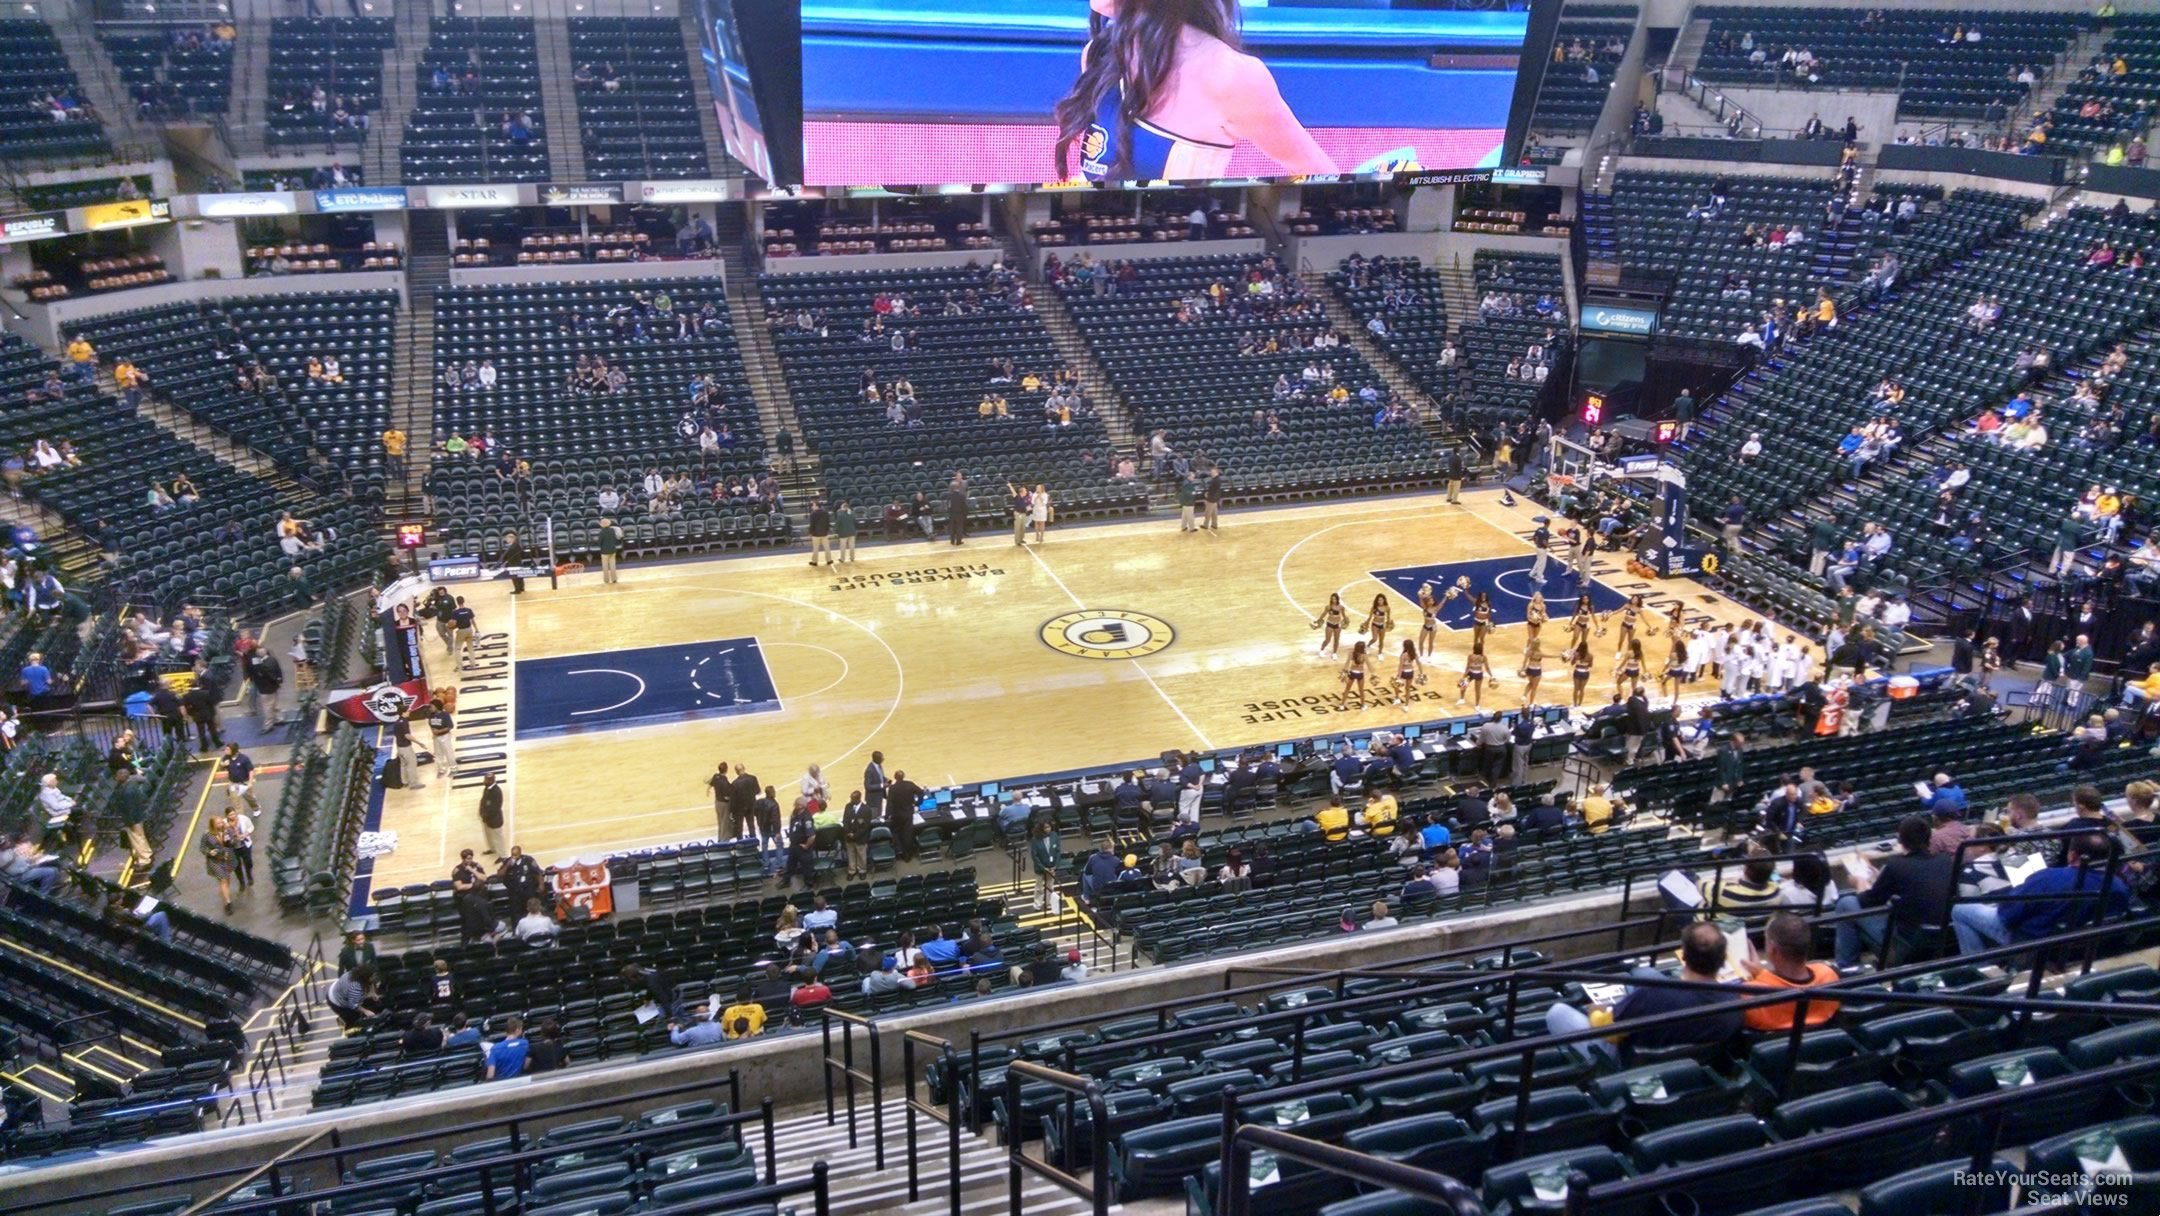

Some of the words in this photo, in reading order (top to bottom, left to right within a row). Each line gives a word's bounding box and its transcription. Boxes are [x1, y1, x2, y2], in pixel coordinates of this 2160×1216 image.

[1409, 175, 1452, 185] MITSUBISHI
[1453, 173, 1490, 184] ELECTRIC
[1504, 169, 1546, 179] GRAPHICS
[335, 193, 358, 205] ETC
[460, 189, 497, 200] STAR
[151, 202, 170, 217] CAT
[4, 217, 56, 233] REPUBLIC
[1610, 313, 1645, 324] citizens
[1585, 405, 1600, 423] 24
[1660, 430, 1671, 440] 24
[404, 533, 420, 544] 24
[444, 565, 478, 577] Pacers
[836, 563, 989, 584] FIELDHOUSE
[890, 568, 1006, 586] BANKERS
[829, 581, 881, 592] LIFE
[1241, 709, 1303, 725] LIFE
[452, 703, 508, 790] INDIANA
